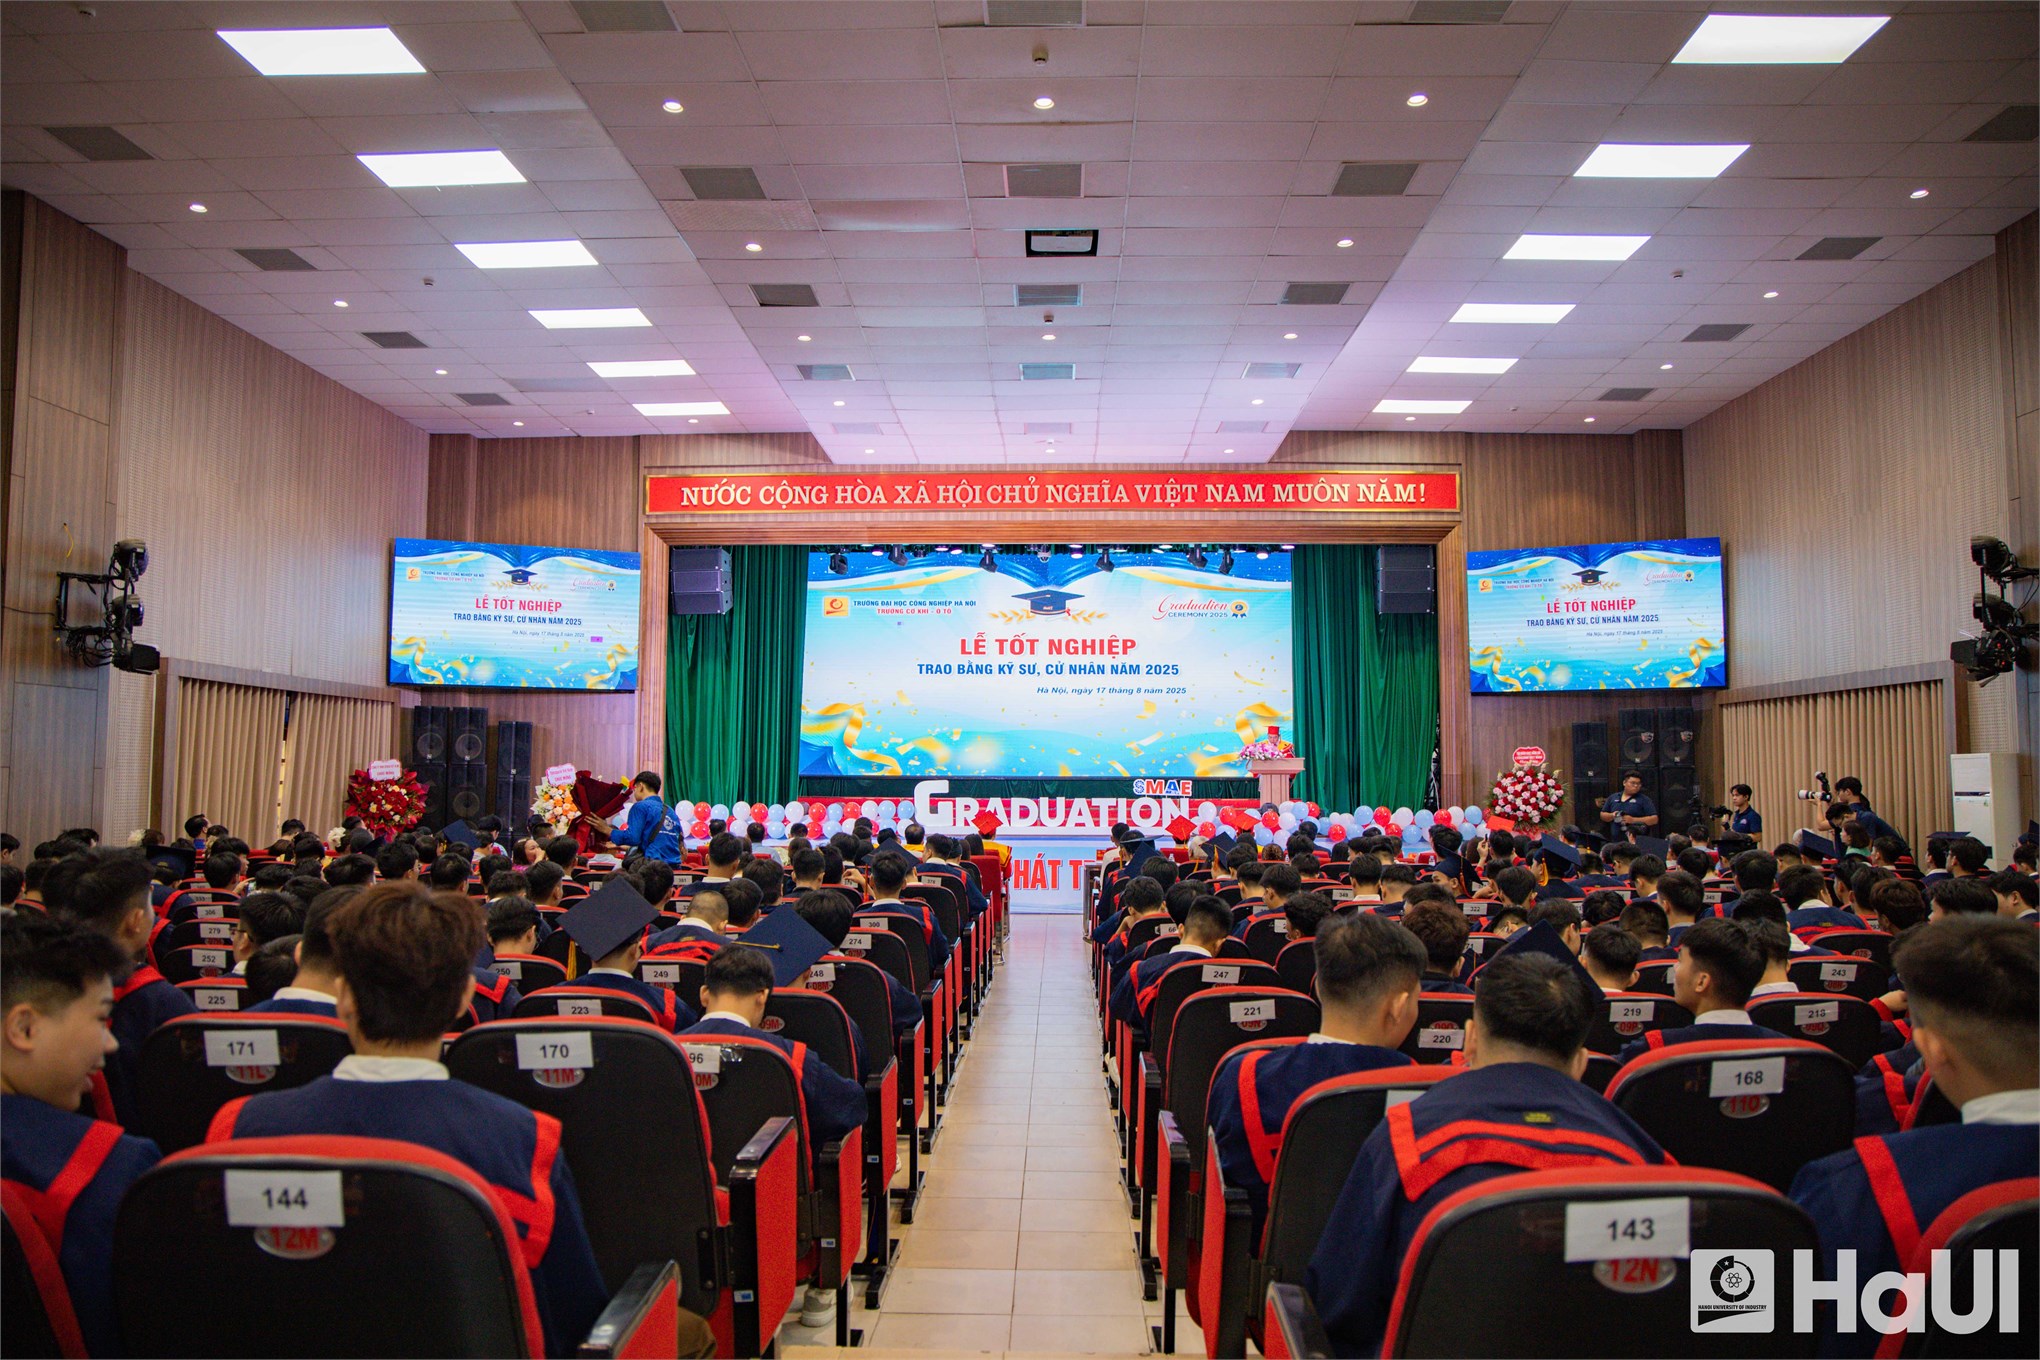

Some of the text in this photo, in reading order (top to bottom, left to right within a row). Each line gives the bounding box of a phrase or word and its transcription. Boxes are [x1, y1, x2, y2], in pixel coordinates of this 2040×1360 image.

[680, 476, 1426, 509] NƯỚC CỘNG HÒA XÃ HỘI CHỦ NGHĨA VIỆT NAM MUÔN NĂM!
[493, 595, 515, 610] TỐT
[520, 598, 562, 614] NGHIỆP
[1152, 593, 1228, 620] Graduation
[1564, 598, 1586, 612] TỐT
[1591, 596, 1636, 612] NGHIỆP
[960, 632, 1137, 659] LỄ TỐT NGHIỆP
[917, 660, 1179, 676] TRAO BẰNG KỸ SƯ, CỬ NHÂN NĂM 2025
[1108, 687, 1134, 695] tháng
[1133, 779, 1192, 796] SMAE
[914, 780, 1193, 828] GRADUATION
[1014, 853, 1062, 890] HÁT
[653, 970, 669, 978] 249
[1214, 970, 1228, 979] 247
[1831, 968, 1846, 977] 243
[208, 996, 226, 1005] 225
[571, 1006, 590, 1015] 223
[1244, 1006, 1262, 1016] 221
[1624, 1008, 1642, 1016] 219
[1432, 1035, 1450, 1044] 220
[226, 1041, 256, 1056] 171
[539, 1044, 570, 1059] 170
[689, 1052, 704, 1064] 96
[542, 1068, 575, 1084] 11M
[696, 1074, 712, 1087] 0M
[1736, 1070, 1764, 1086] 168
[262, 1188, 308, 1210] 144
[1607, 1218, 1654, 1241] 143
[270, 1226, 320, 1250] 12M
[1608, 1258, 1659, 1283] 12N
